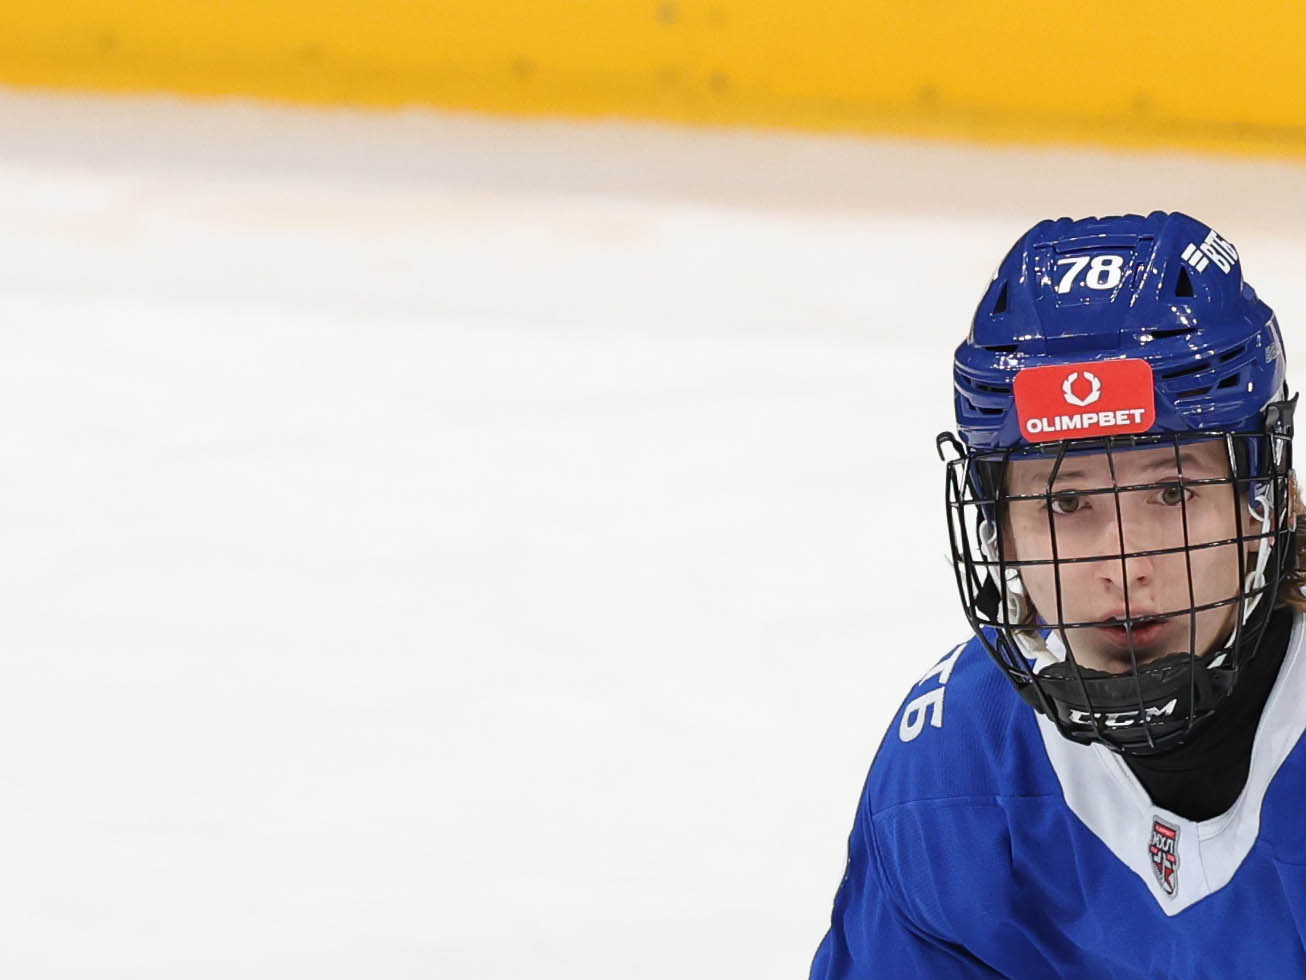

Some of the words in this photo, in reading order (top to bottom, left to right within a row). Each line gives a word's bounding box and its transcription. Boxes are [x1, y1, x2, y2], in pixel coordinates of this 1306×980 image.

[1056, 254, 1123, 294] 78
[1026, 408, 1146, 433] OLIMPBET
[1069, 699, 1177, 726] CCM
